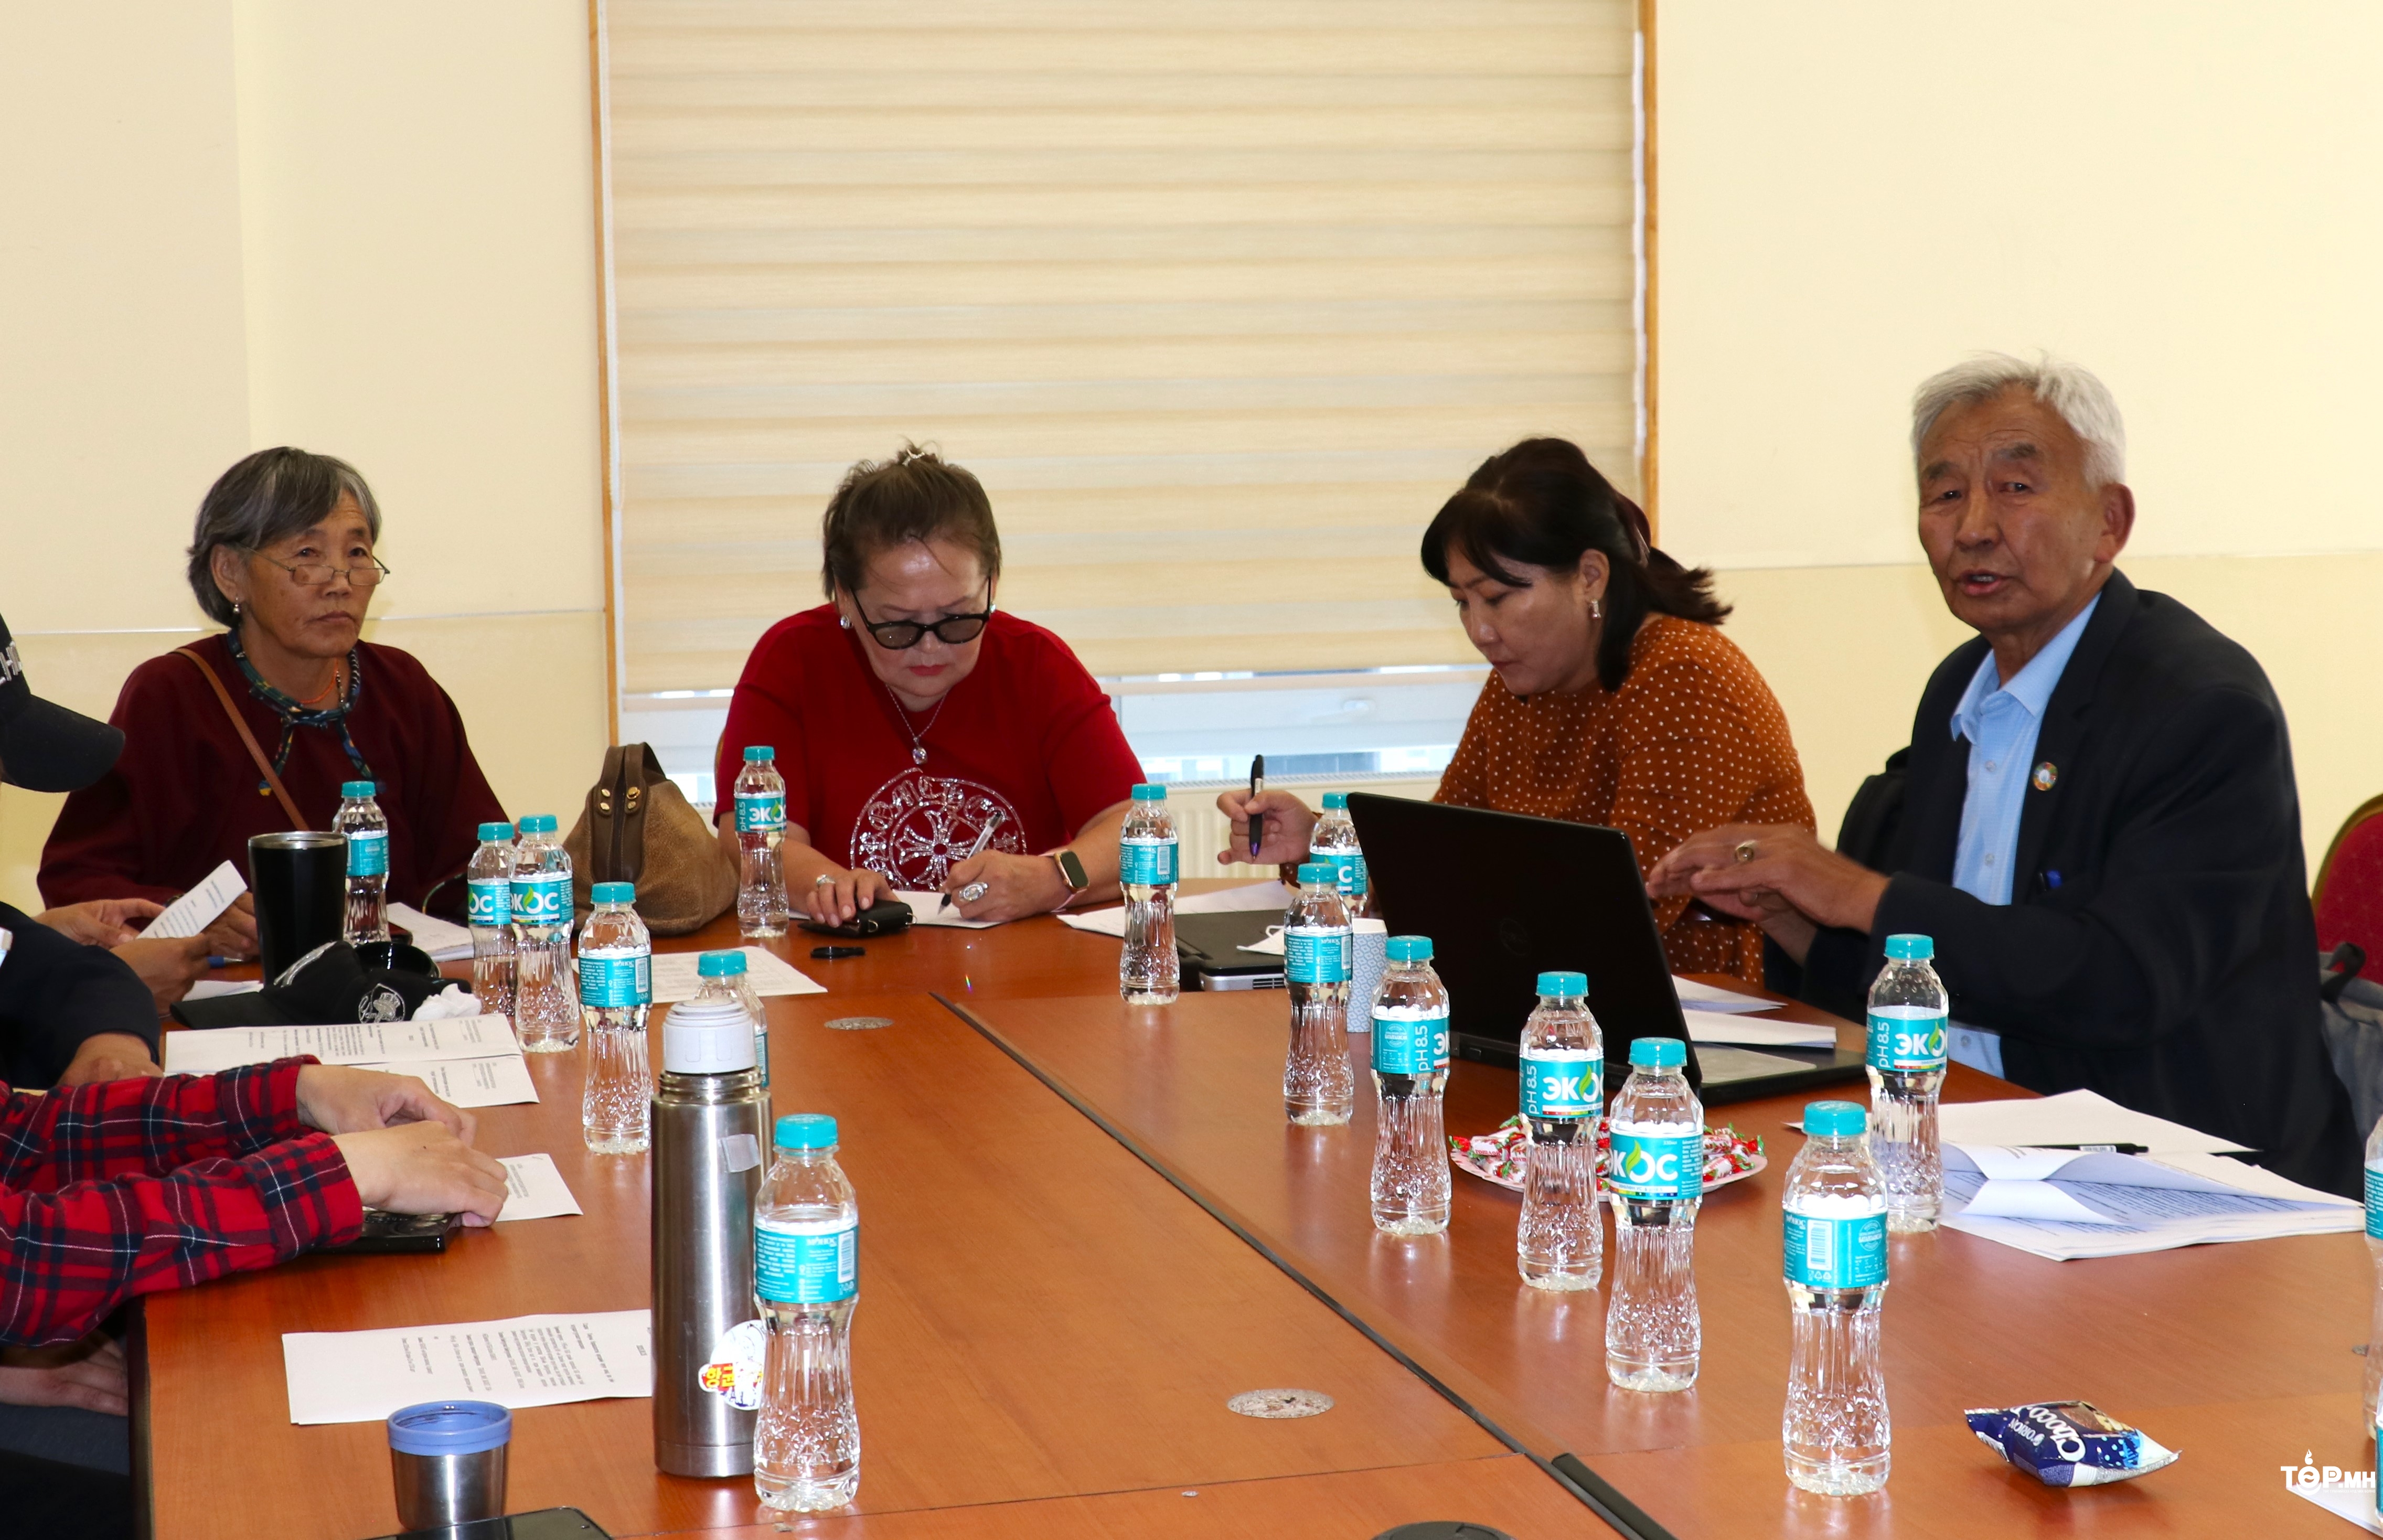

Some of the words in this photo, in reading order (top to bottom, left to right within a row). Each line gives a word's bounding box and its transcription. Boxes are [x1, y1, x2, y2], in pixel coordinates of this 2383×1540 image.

[749, 803, 786, 823] ЭКО
[468, 891, 493, 914] ОС
[1415, 1025, 1428, 1047] 8.5
[1877, 1021, 1890, 1044] 8.5
[1894, 1026, 1948, 1057] ЭКО
[1415, 1049, 1431, 1071] pH
[1877, 1045, 1892, 1068] pH
[1526, 1065, 1537, 1089] 8.5
[1542, 1070, 1604, 1103] ЭКО
[1526, 1090, 1540, 1115] pH
[2008, 1418, 2036, 1440] ORION
